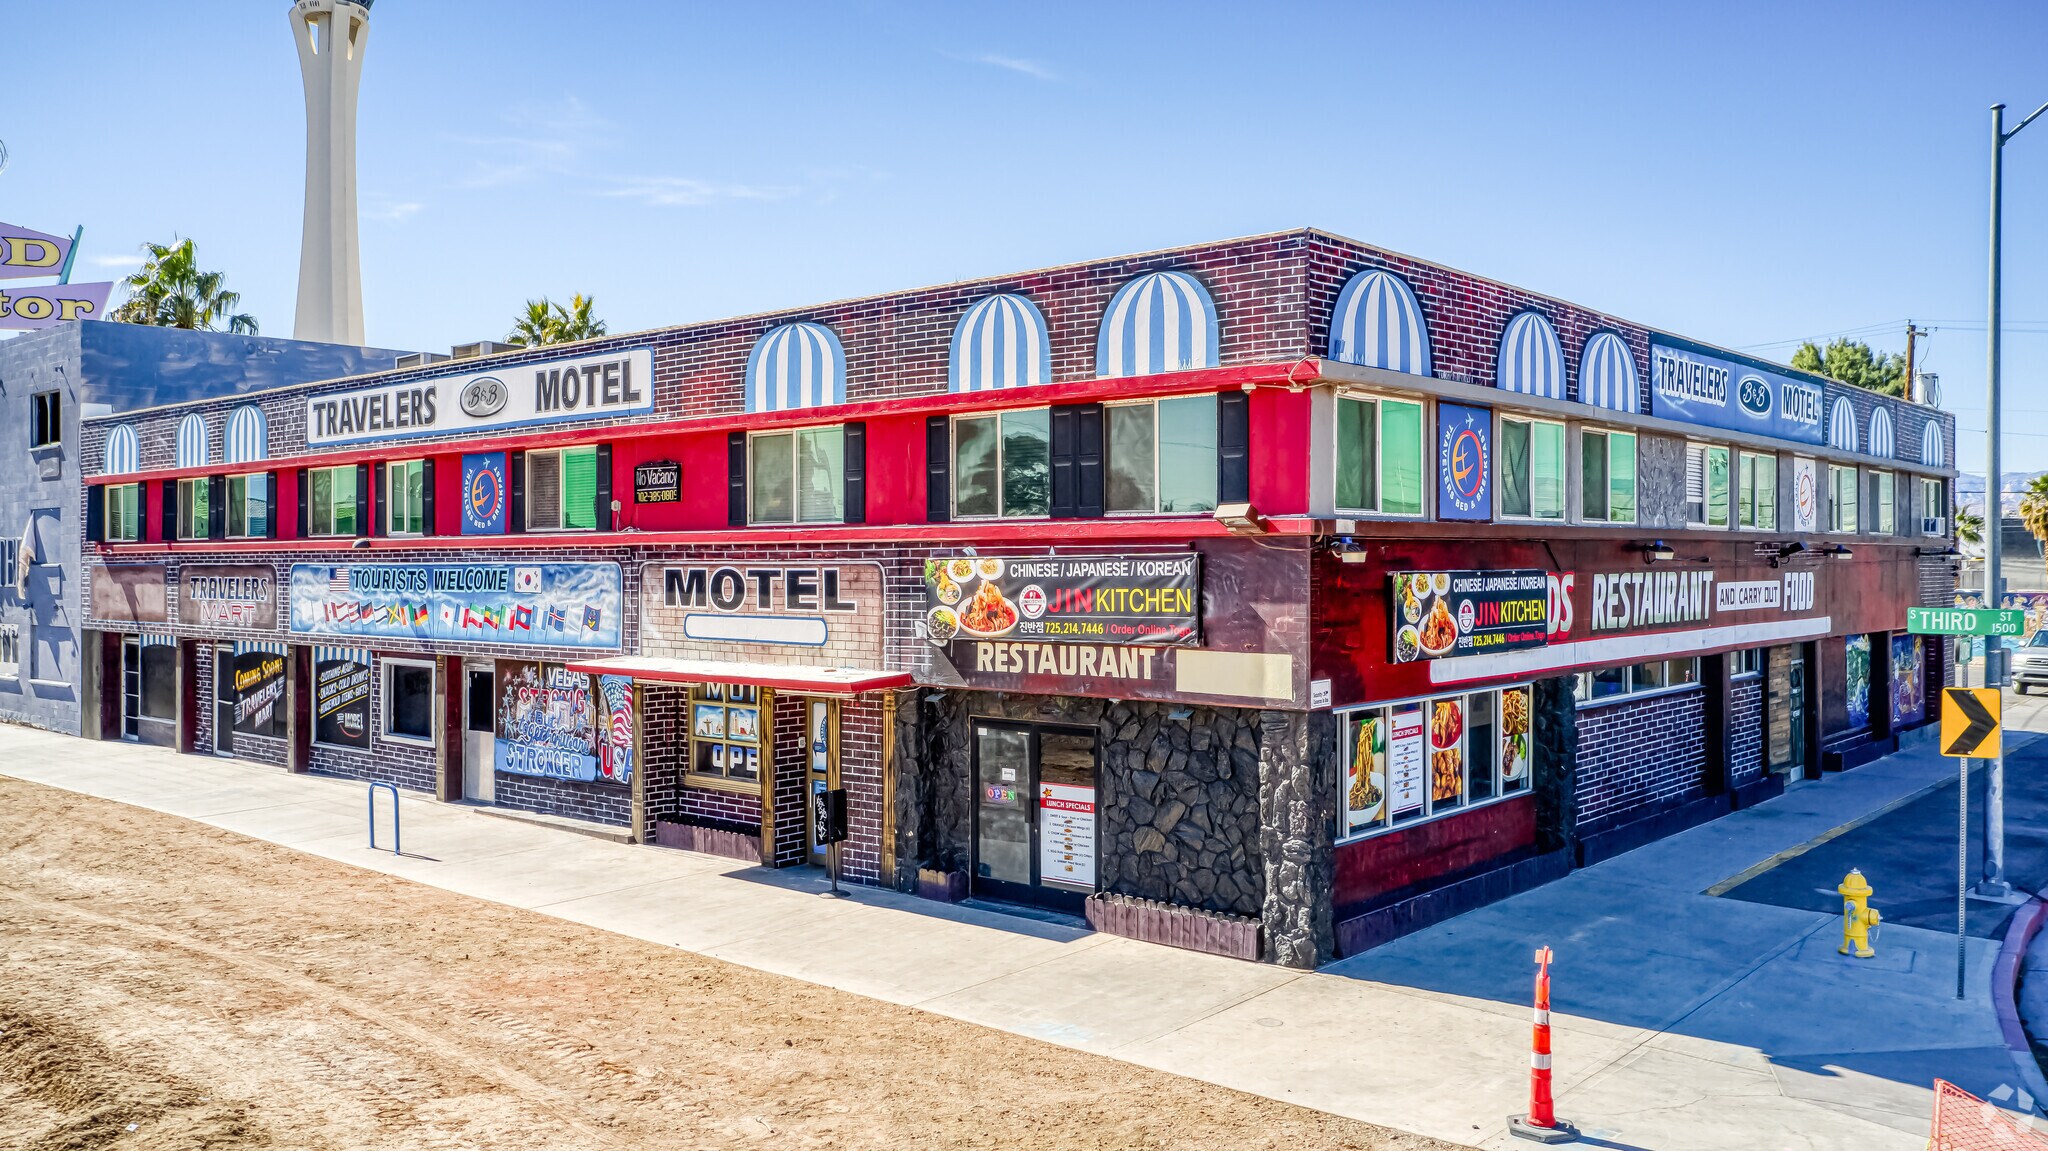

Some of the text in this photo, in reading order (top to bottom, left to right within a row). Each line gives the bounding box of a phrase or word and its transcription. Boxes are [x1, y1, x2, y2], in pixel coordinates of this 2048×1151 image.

[0, 237, 61, 267] D
[313, 359, 642, 438] TRAVELERS B&B MOTEL
[1658, 355, 1818, 425] TRAVELERS B&B MOTEL
[636, 469, 677, 487] No Vacancy
[1442, 424, 1455, 500] TRAVELERS
[1455, 498, 1469, 511] BED
[352, 567, 509, 593] TOURISTS WELCOME
[1010, 563, 1058, 577] CHINESE
[1066, 562, 1128, 577] JAPANESE
[1137, 561, 1191, 576] KOREAN
[190, 576, 269, 602] TRAVELERS
[663, 566, 857, 614] MOTEL
[1453, 578, 1482, 593] CHINESE
[1486, 577, 1517, 592] JAPANESE
[1521, 576, 1546, 590] KOREAN
[201, 602, 256, 625] MART
[1048, 588, 1092, 613] JIN
[1096, 588, 1191, 612] KITCHEN
[1475, 600, 1545, 626] JIN KITCHEN
[1592, 570, 1713, 631] RESTAURANT
[1720, 588, 1735, 605] AND
[1738, 587, 1763, 605] CARRY
[1764, 586, 1778, 603] OUT
[1783, 571, 1814, 611] FOOD
[1019, 621, 1044, 634] 진반점
[1045, 622, 1104, 635] 725.214.7446
[1110, 624, 1135, 634] Order
[1910, 609, 2013, 631] S THIRD ST
[1992, 623, 2017, 634] 1500
[1473, 633, 1505, 647] 725.214.7446
[977, 641, 1156, 680] RESTAURANT
[235, 658, 283, 692] COMING SOON!
[546, 667, 590, 690] VEGAS
[240, 681, 277, 721] TRAVELERS
[254, 701, 273, 728] MART
[505, 742, 582, 778] STRONGER
[987, 787, 1015, 800] OPEN
[1046, 800, 1091, 811] LUNCH SPECIALS
